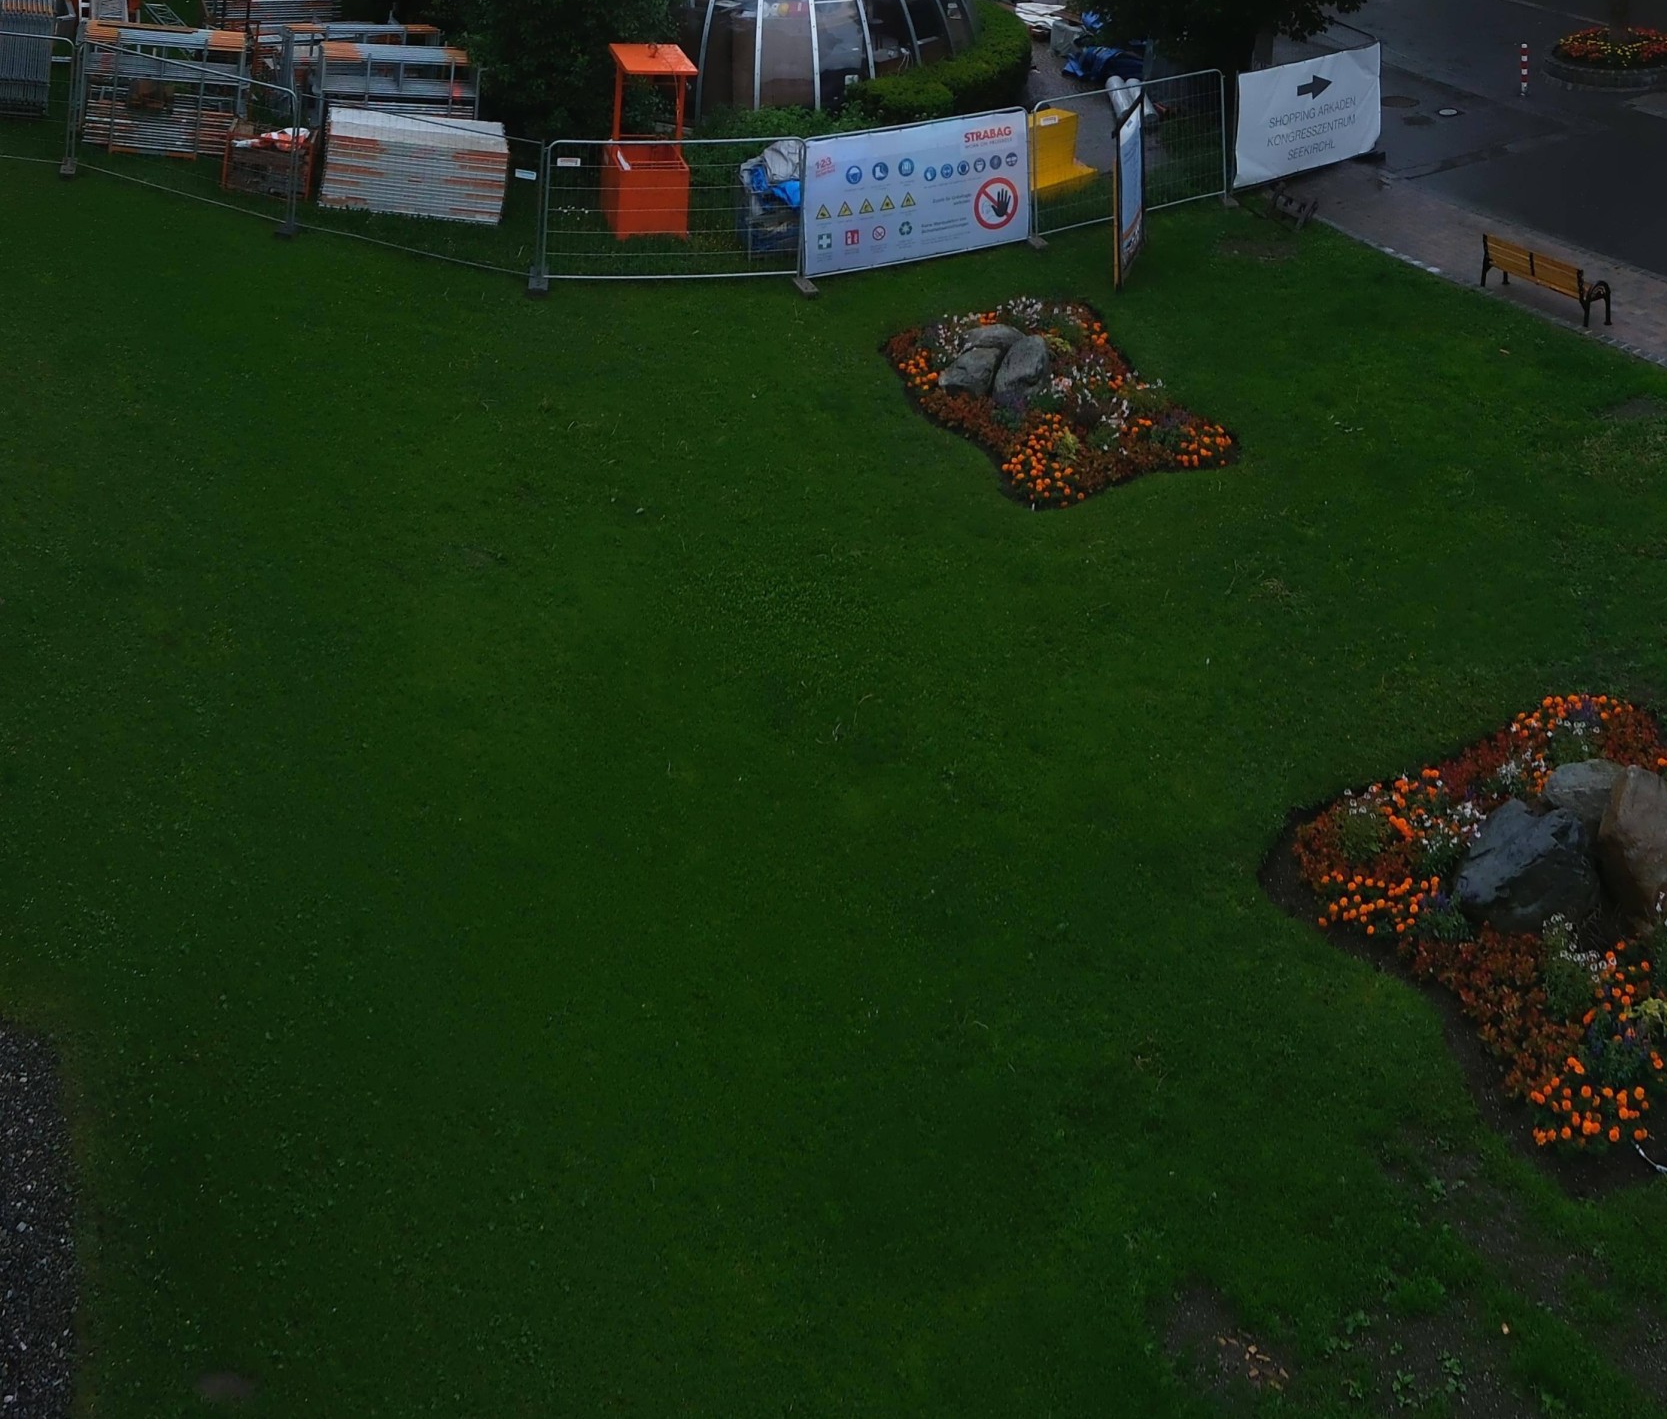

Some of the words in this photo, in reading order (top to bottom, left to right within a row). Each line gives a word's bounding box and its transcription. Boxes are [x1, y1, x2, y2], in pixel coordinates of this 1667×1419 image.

[1269, 108, 1316, 129] SHOPPING
[1317, 96, 1356, 118] ARKADEN
[964, 126, 1012, 143] STRABAG
[1267, 114, 1356, 147] KONGRESSZENTRUM
[1287, 140, 1336, 161] SEEKIRCHL
